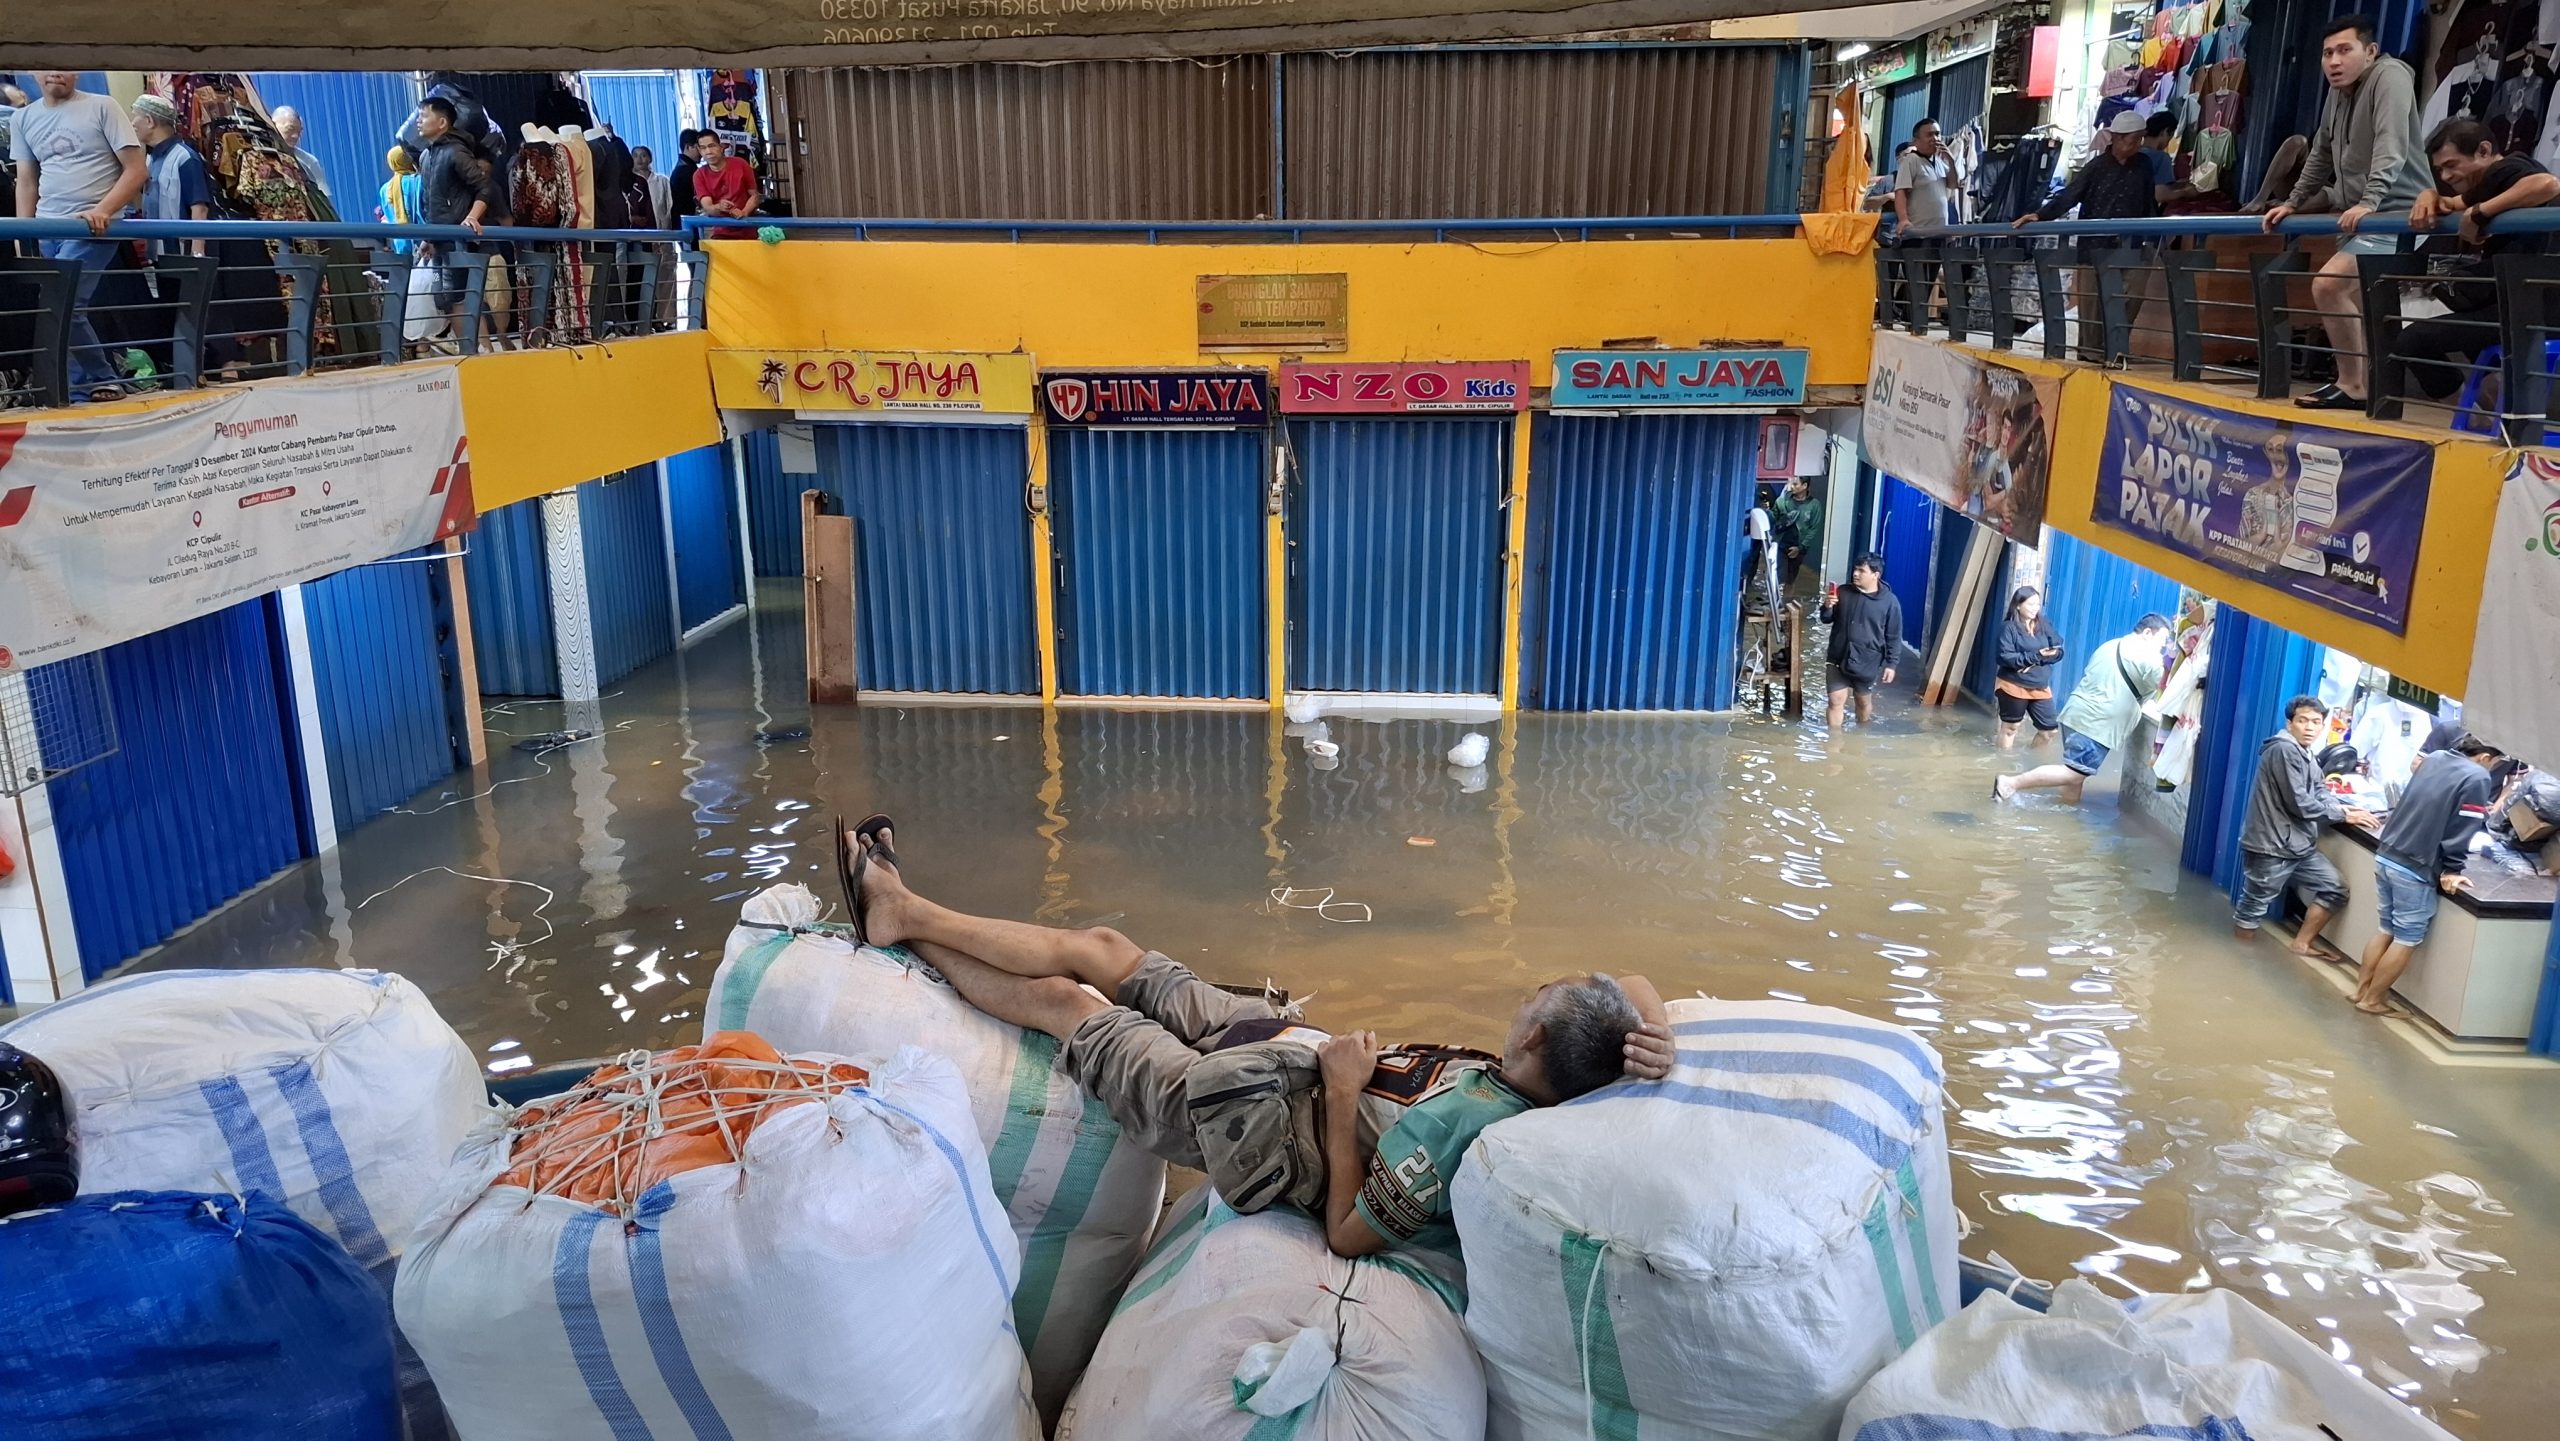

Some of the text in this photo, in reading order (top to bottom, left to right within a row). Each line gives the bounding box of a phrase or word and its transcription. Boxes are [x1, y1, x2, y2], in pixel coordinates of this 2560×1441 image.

[1227, 281, 1338, 300] BUANGLAH SAMPAH
[1233, 300, 1332, 317] PADA TEMPATNYA
[875, 359, 981, 400] JAYA
[1570, 357, 1787, 389] SAN JAYA
[417, 380, 450, 393] BANK DKI
[1091, 378, 1263, 412] HIN JAYA
[1464, 378, 1517, 399] Kids
[1744, 387, 1794, 398] FASHION
[1872, 364, 1896, 408] BSI
[1937, 392, 1951, 409] Pasar
[213, 411, 299, 441] Pengumuman
[2147, 402, 2221, 460] PILIH
[81, 476, 123, 491] Terhitung
[125, 468, 150, 484] Efektif
[152, 467, 165, 477] Per
[166, 460, 194, 474] Tanggal
[195, 457, 199, 468] 9
[201, 452, 239, 467] Desember
[241, 447, 256, 458] 2024
[257, 444, 280, 455] Kantor
[281, 439, 306, 450] Cabang
[307, 433, 337, 446] Pembantu
[338, 431, 354, 440] Pasar
[355, 426, 375, 438] Cipulir
[153, 444, 354, 492] Terima Kasih Atas Kepercayaan Seluruh Nasabah & Mitra Usaha
[2120, 438, 2214, 501] LAPOR
[63, 512, 89, 527] Untuk
[89, 499, 150, 521] Mempermudah
[152, 493, 187, 508] Layanan
[187, 486, 213, 500] Kepada
[248, 475, 264, 486] Maka
[266, 468, 293, 482] Kegiatan
[293, 461, 322, 475] Transaksi
[323, 460, 339, 471] Serta
[340, 456, 362, 468] Layanan
[363, 452, 380, 462] Dapat
[381, 447, 405, 459] Dilakukan
[300, 508, 308, 518] KC
[322, 501, 347, 513] Kebayoran
[346, 498, 359, 507] Lama
[2119, 480, 2212, 549] PAJAK
[186, 532, 222, 548] KCP Cipulir
[2208, 529, 2222, 542] KPP
[2222, 534, 2253, 553] PRATAMA
[2333, 536, 2347, 549] Ini
[174, 553, 197, 566] Ciledug
[197, 549, 213, 560] Raya
[149, 571, 180, 585] Kebayoran
[181, 566, 198, 577] Lama
[2331, 562, 2375, 586] pajak.go.id
[2398, 679, 2428, 704] EXIT
[1378, 1170, 1398, 1198] APPAREL
